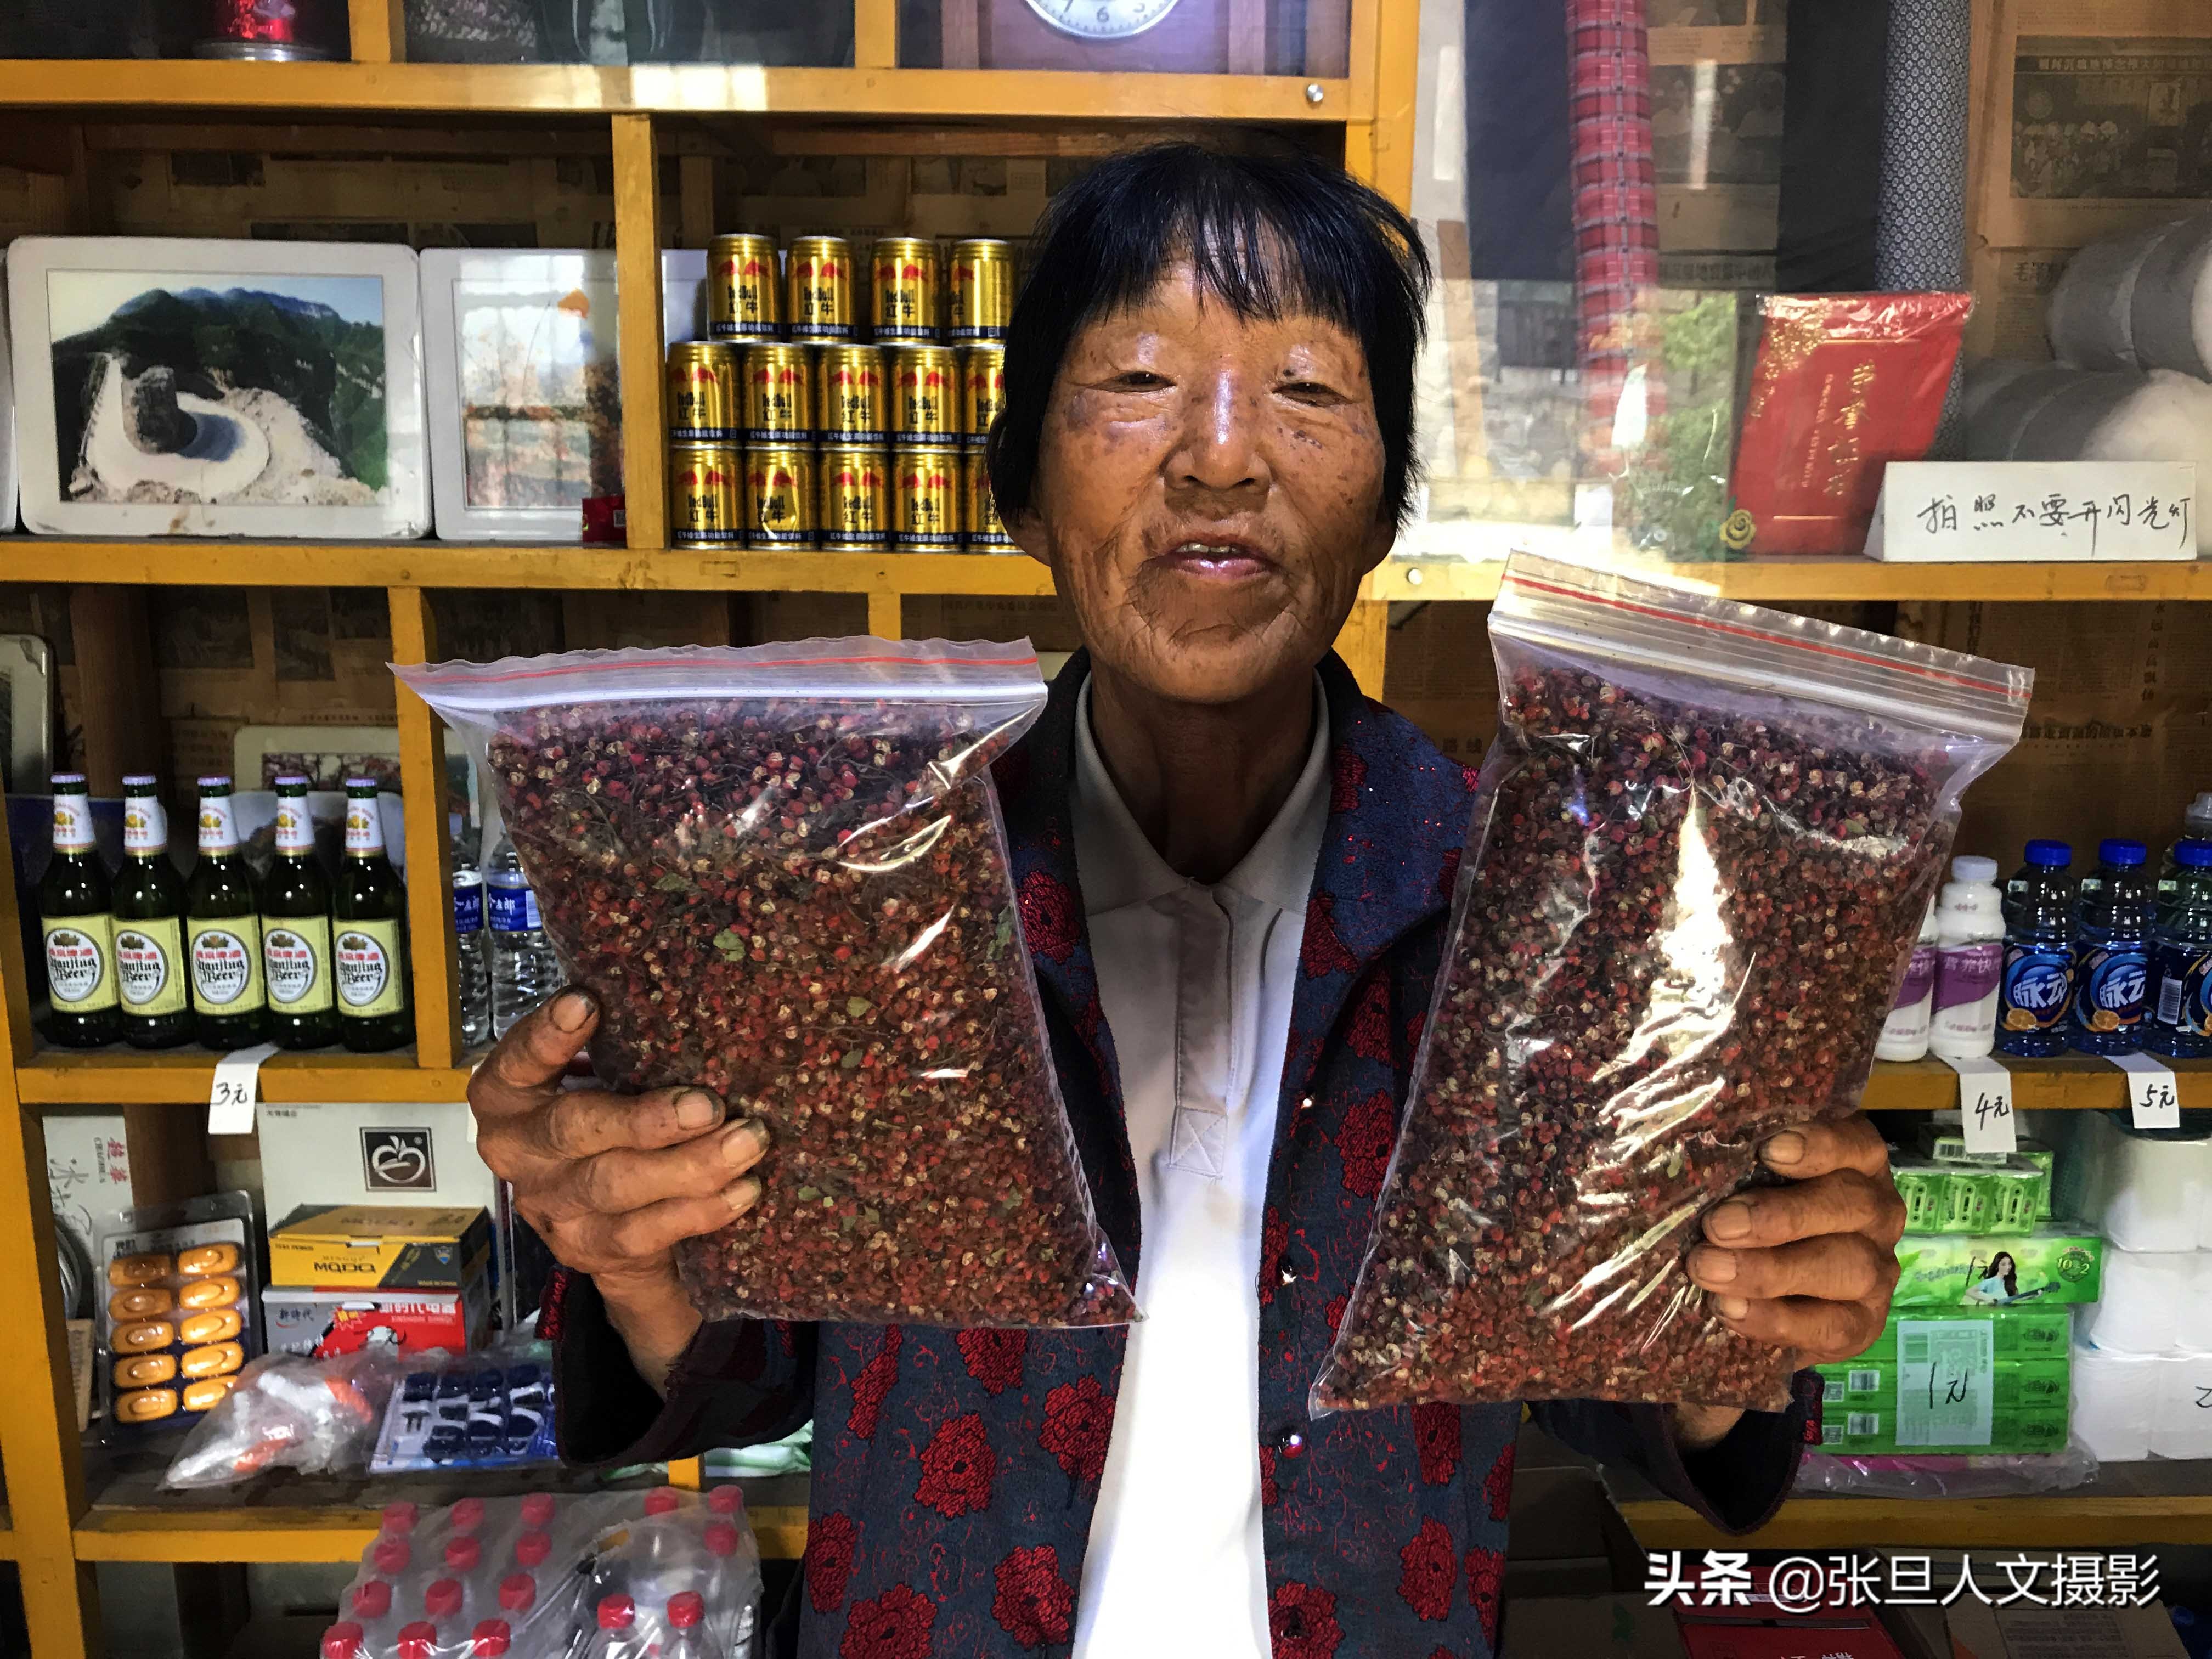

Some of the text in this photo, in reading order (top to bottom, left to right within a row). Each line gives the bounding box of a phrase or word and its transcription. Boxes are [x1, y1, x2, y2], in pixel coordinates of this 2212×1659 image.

[1097, 6, 1109, 22] 6
[1917, 494, 2191, 556] 拍照不要开闪光灯
[2013, 972, 2068, 1008] 脉动
[213, 1082, 248, 1106] 3元
[2139, 1083, 2175, 1107] 5元
[1974, 1092, 2010, 1130] 4元
